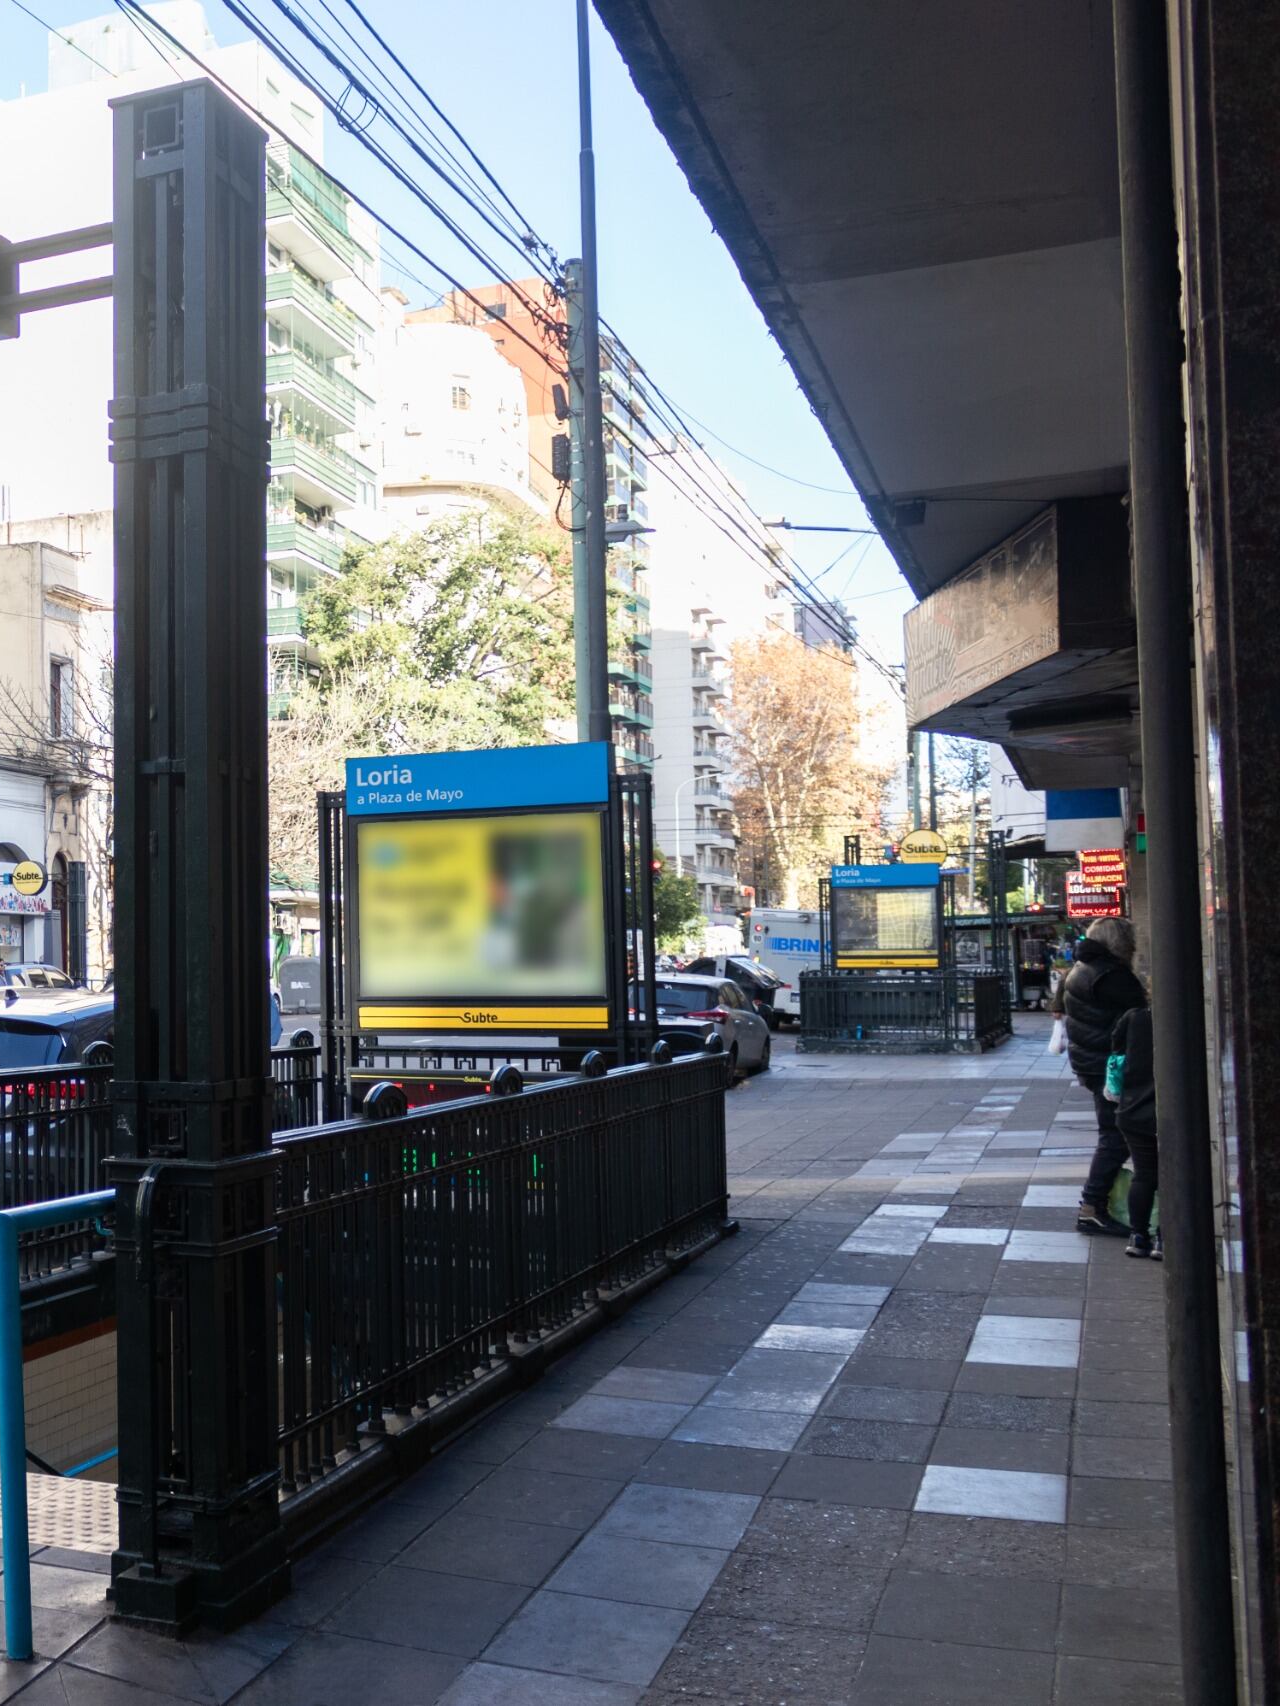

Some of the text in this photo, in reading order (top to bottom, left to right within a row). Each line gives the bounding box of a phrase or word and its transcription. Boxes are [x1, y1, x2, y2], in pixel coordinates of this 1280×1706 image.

[356, 764, 413, 787] Loria
[357, 788, 464, 805] a Plaza de Mayo
[905, 843, 940, 854] Subte
[16, 872, 40, 880] Subte
[835, 868, 861, 877] Loria
[464, 1012, 498, 1023] Subte
